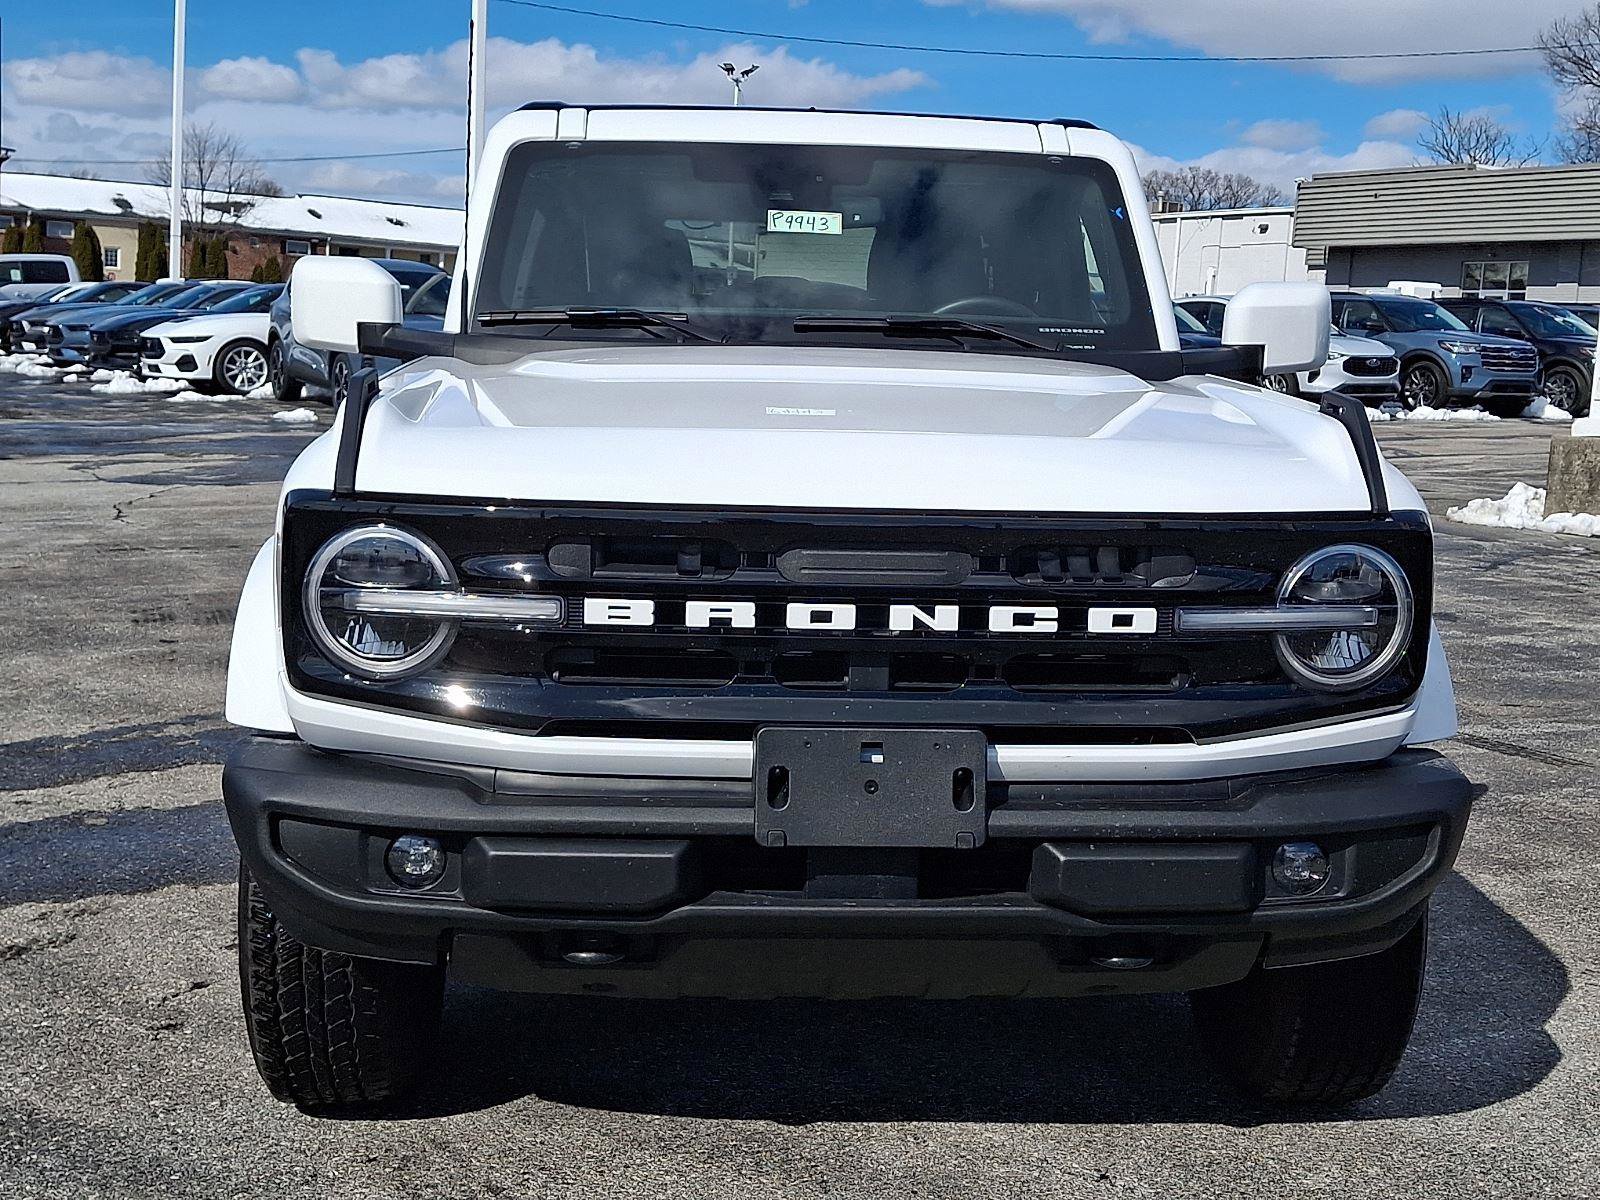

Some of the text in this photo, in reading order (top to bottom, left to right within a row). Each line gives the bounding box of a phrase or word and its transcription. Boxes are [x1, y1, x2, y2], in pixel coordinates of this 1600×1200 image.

[771, 212, 829, 231] P9943
[1038, 327, 1105, 335] BRONCO
[583, 598, 1158, 634] BRONCO
